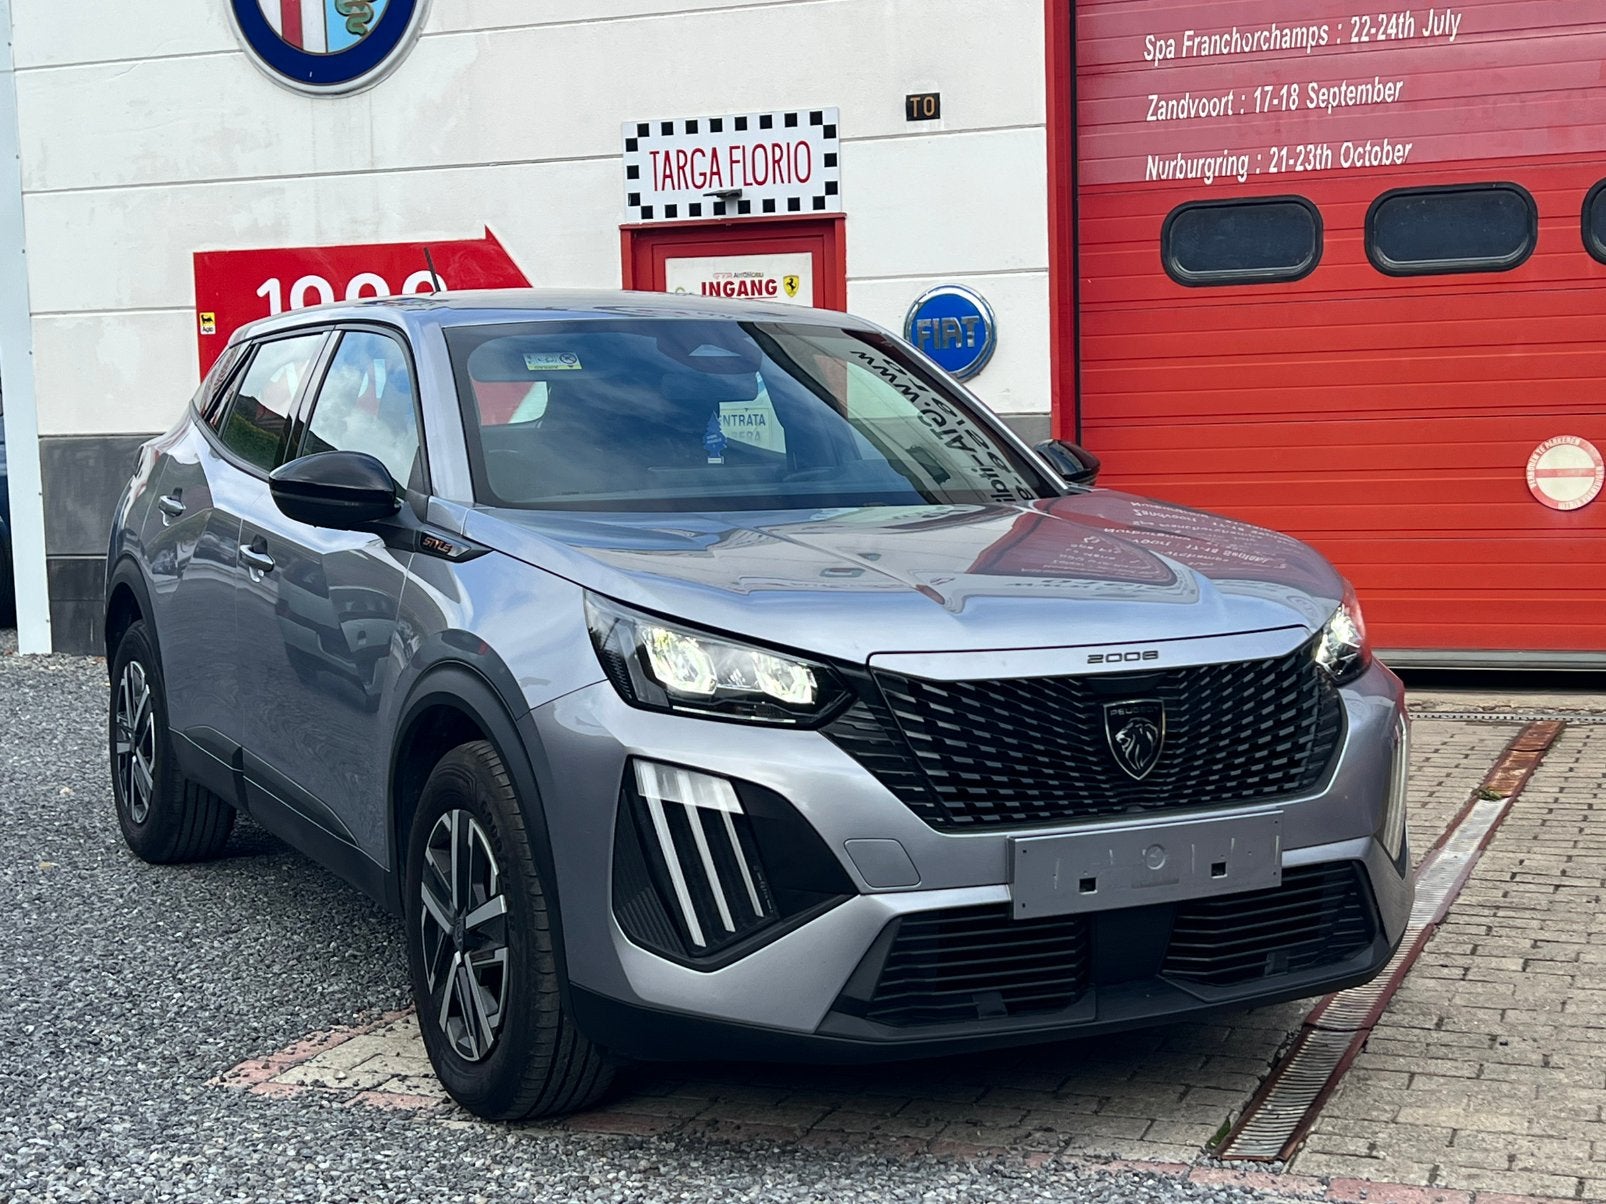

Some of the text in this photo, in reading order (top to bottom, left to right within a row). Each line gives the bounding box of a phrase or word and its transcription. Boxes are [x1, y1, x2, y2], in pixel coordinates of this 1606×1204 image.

[1143, 34, 1176, 66] Spa
[1182, 22, 1329, 58] Franchorchamps
[1350, 10, 1415, 43] 22-24th
[1422, 8, 1462, 42] July
[910, 96, 936, 118] TO
[1146, 89, 1234, 121] Zandvoort
[1253, 83, 1300, 114] 17-18
[1306, 76, 1404, 115] September
[649, 140, 811, 192] TARGA FLORIO
[1145, 149, 1249, 185] Nurburgring
[1268, 143, 1332, 174] 21-23th
[1339, 138, 1413, 169] October
[701, 278, 778, 298] INGANG
[916, 315, 980, 351] FIAT
[719, 413, 766, 428] NTRATA
[1087, 650, 1159, 664] 2008
